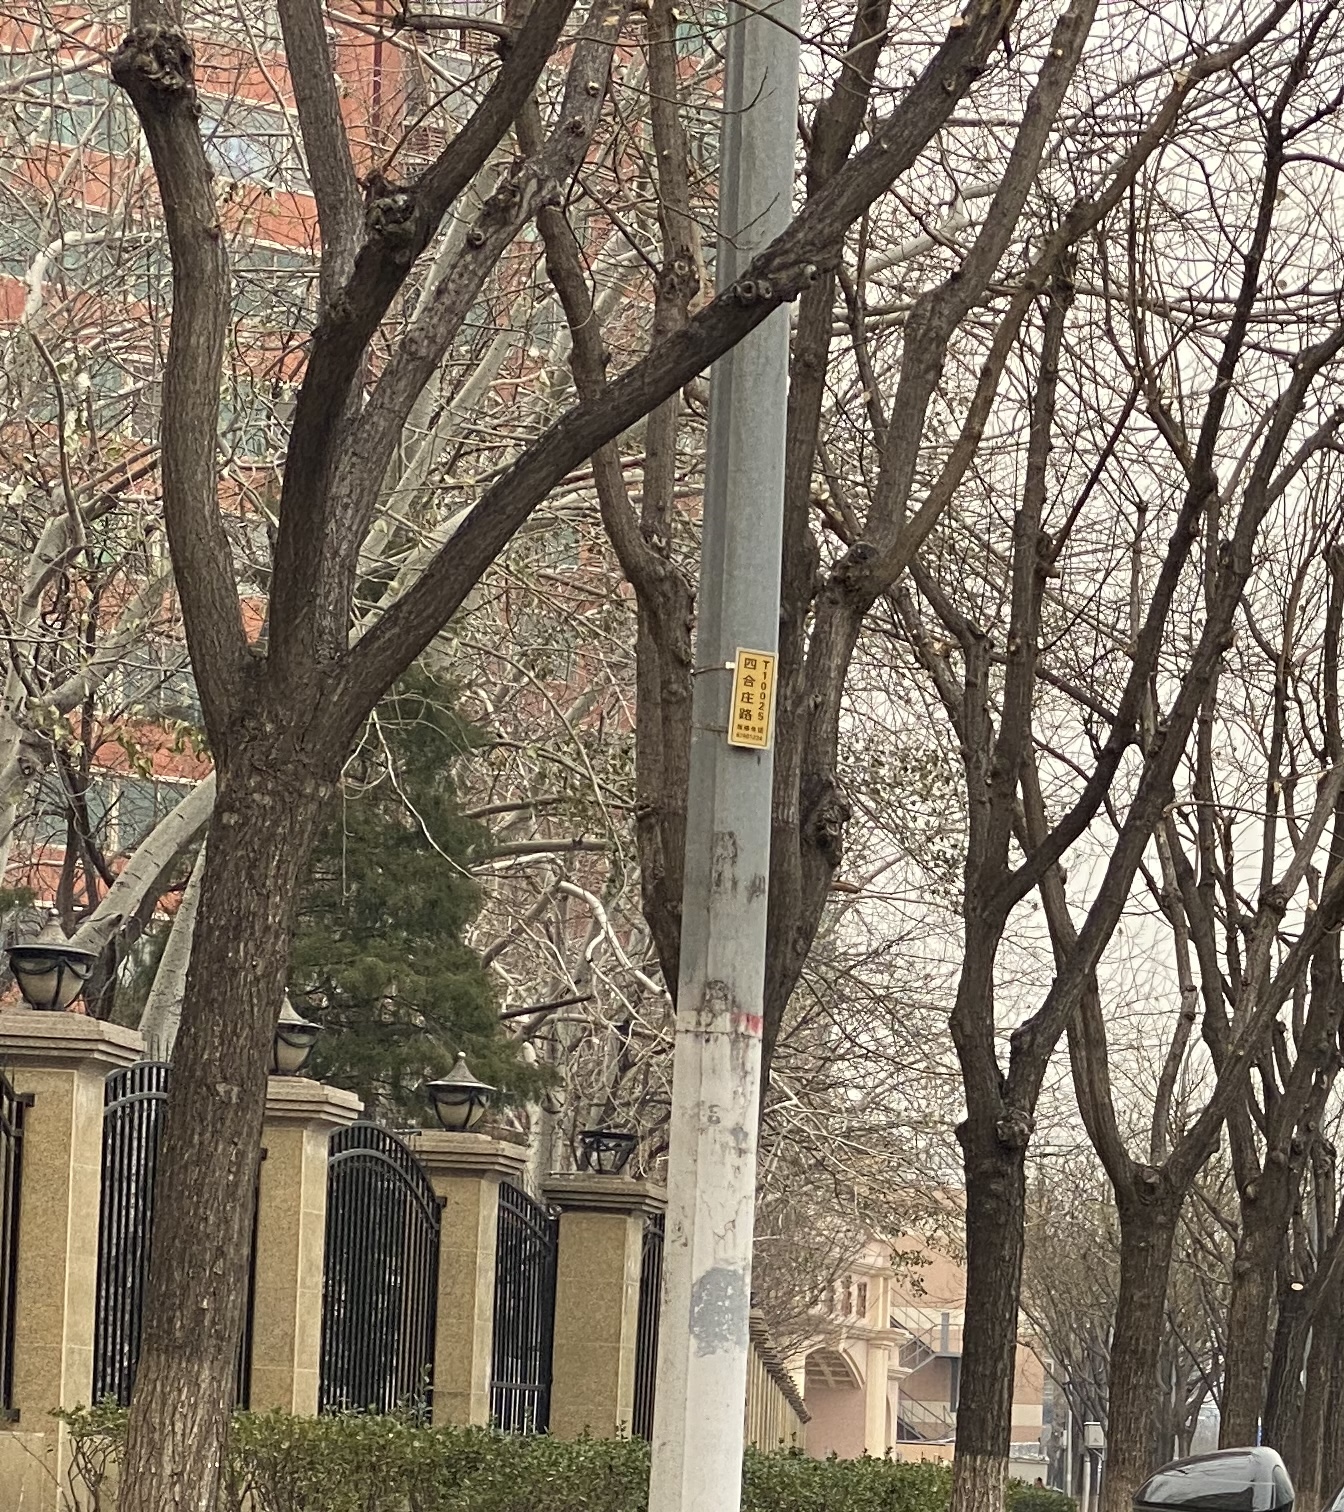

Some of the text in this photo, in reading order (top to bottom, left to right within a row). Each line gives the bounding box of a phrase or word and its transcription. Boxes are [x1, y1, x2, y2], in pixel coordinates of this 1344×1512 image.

[739, 658, 757, 722] 四合庄路
[757, 660, 771, 721] T10025
